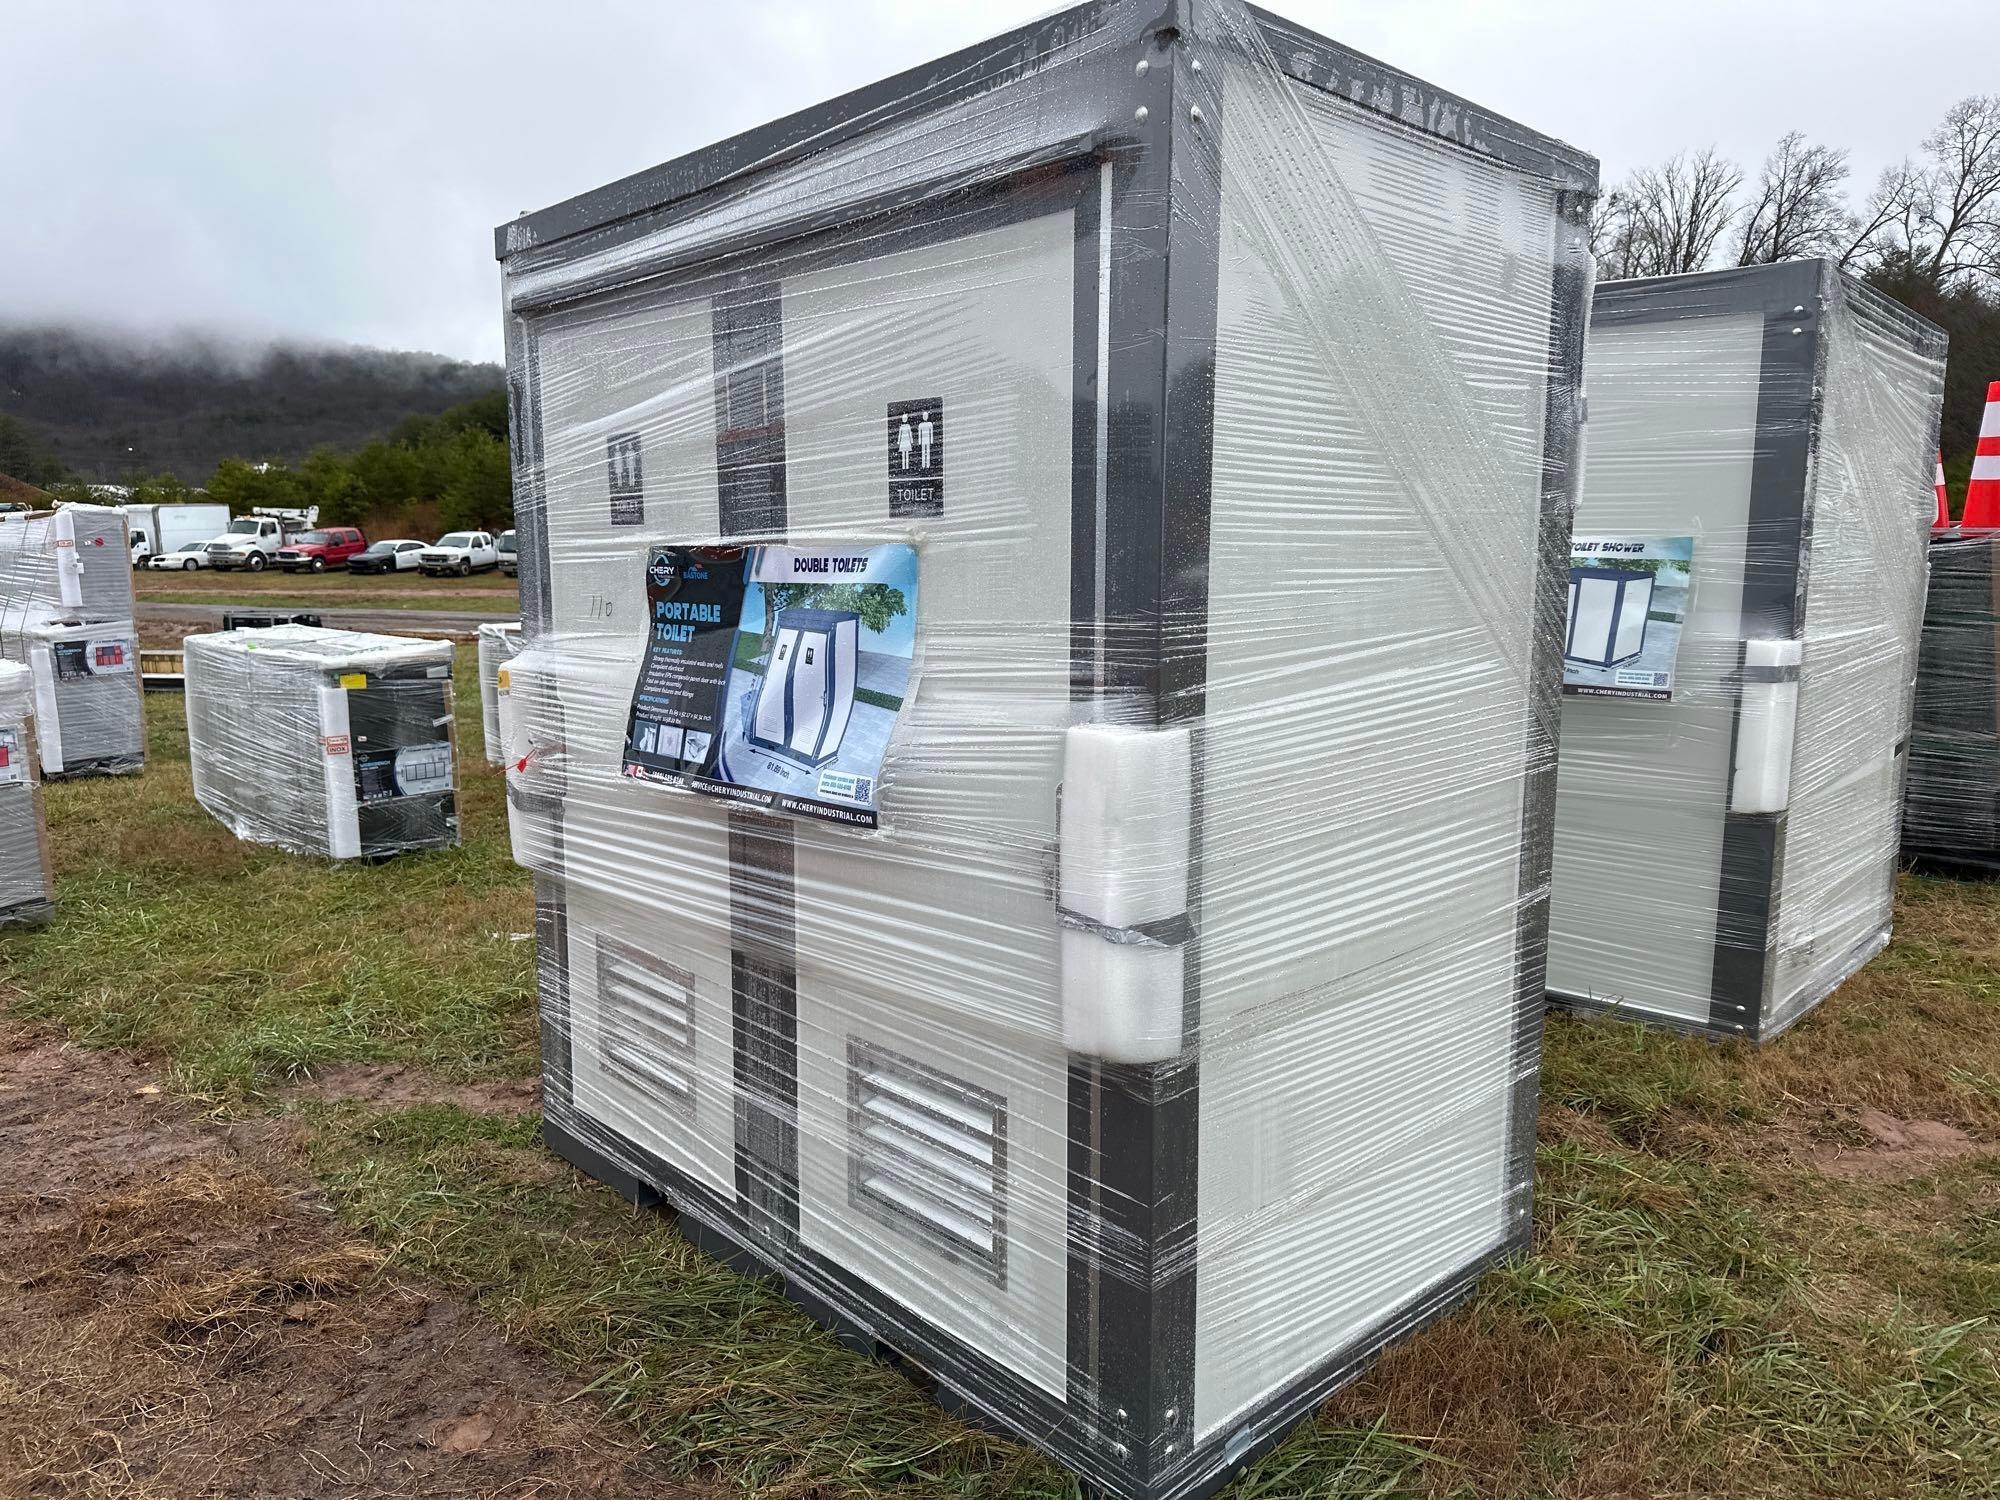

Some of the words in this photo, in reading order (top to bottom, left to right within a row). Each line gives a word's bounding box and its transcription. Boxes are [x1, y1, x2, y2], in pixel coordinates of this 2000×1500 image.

[897, 487, 935, 501] TOILET
[1602, 542, 1645, 553] SHOWER
[649, 566, 675, 575] CHERY
[793, 557, 829, 573] DOUBLE
[832, 557, 869, 573] TOILETS
[655, 601, 721, 623] PORTABLE
[656, 622, 696, 643] TOILET
[1577, 686, 1668, 701] WWW.CHERYINDUSTRIAL.COM
[766, 761, 781, 774] 81.69
[781, 798, 873, 825] WWW.CHERYINDUSTRIAL.COM
